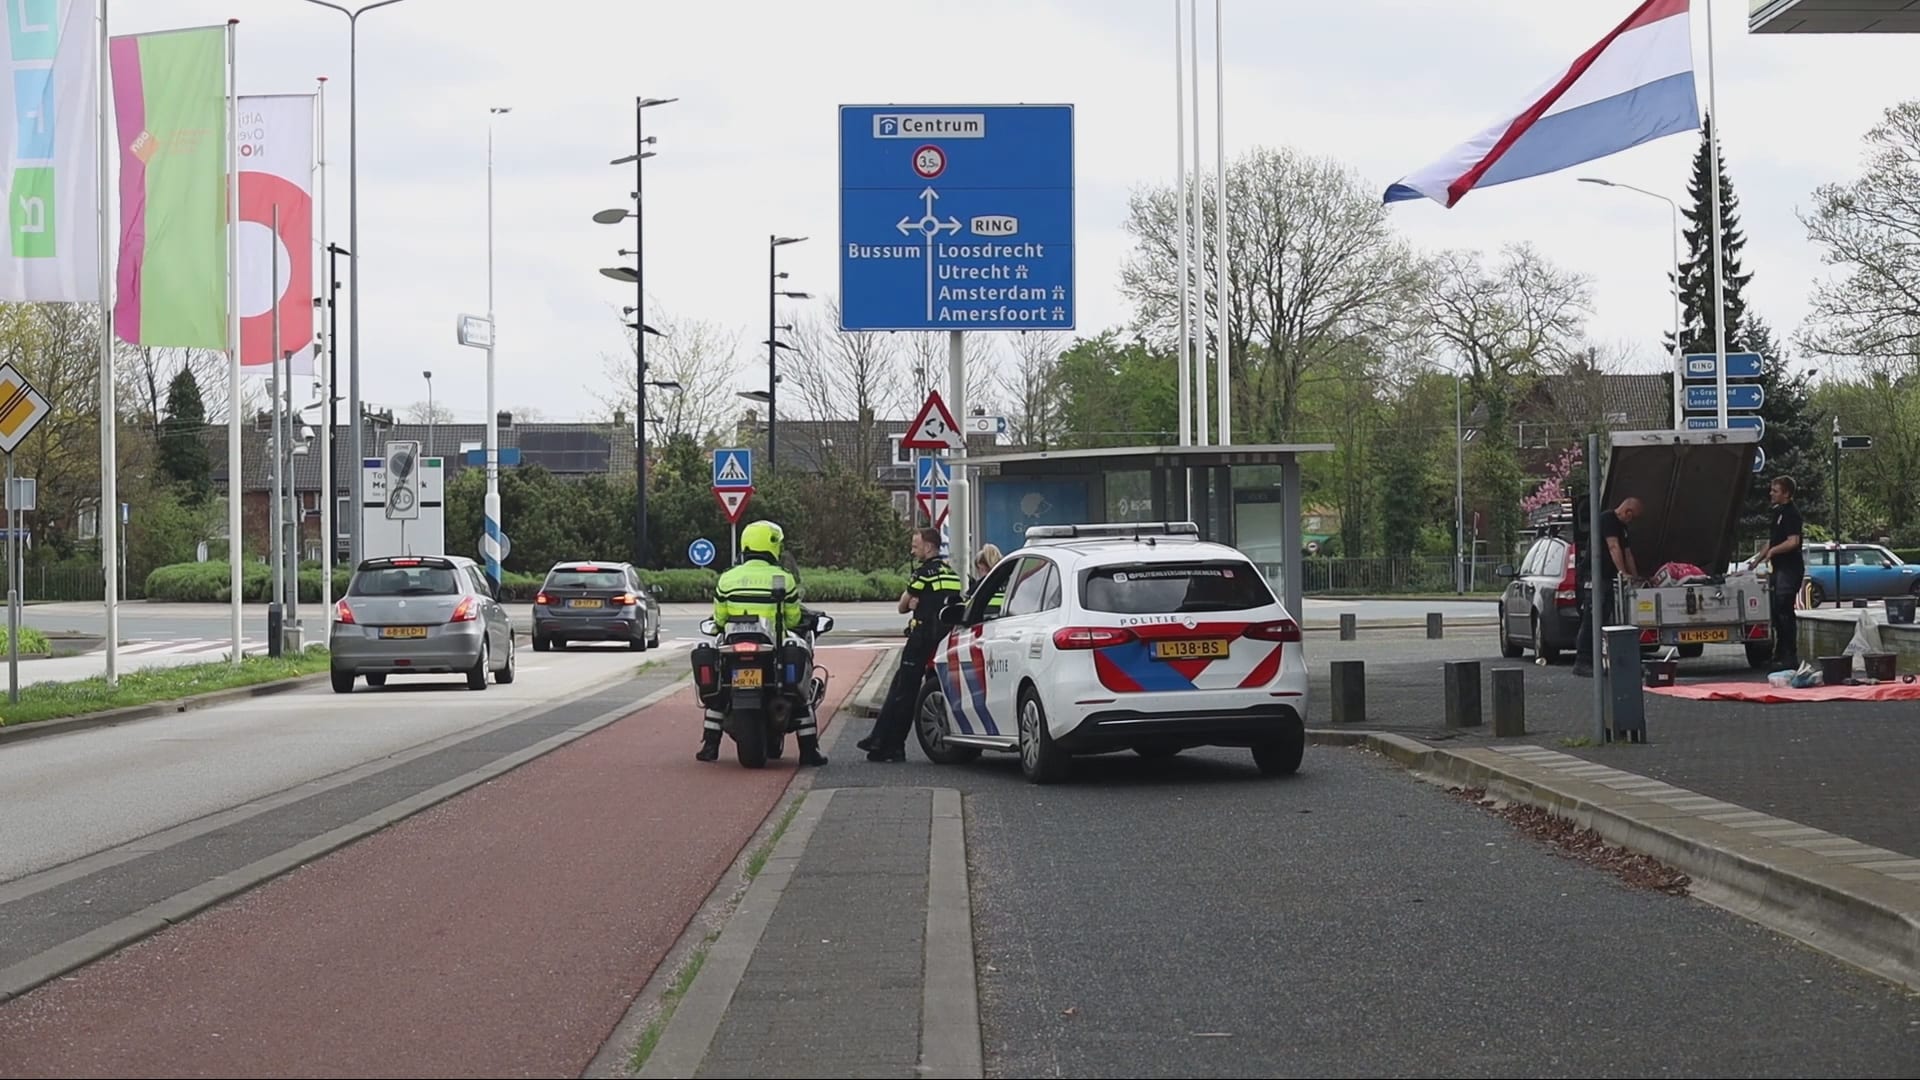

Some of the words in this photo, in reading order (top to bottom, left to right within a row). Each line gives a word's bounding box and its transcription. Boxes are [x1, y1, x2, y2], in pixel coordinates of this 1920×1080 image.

[902, 118, 978, 132] Centrum
[975, 220, 1013, 232] RING
[848, 243, 921, 258] Bussum
[938, 243, 1044, 258] Loosdrecht
[938, 264, 1010, 279] Utrecht
[938, 285, 1046, 300] Amsterdam
[938, 306, 1047, 321] Amersfoort
[1689, 420, 1718, 428] Utrecht
[1119, 615, 1178, 626] POLITIE
[1680, 631, 1725, 641] WL-HS-04
[1162, 641, 1220, 656] L-138-BS
